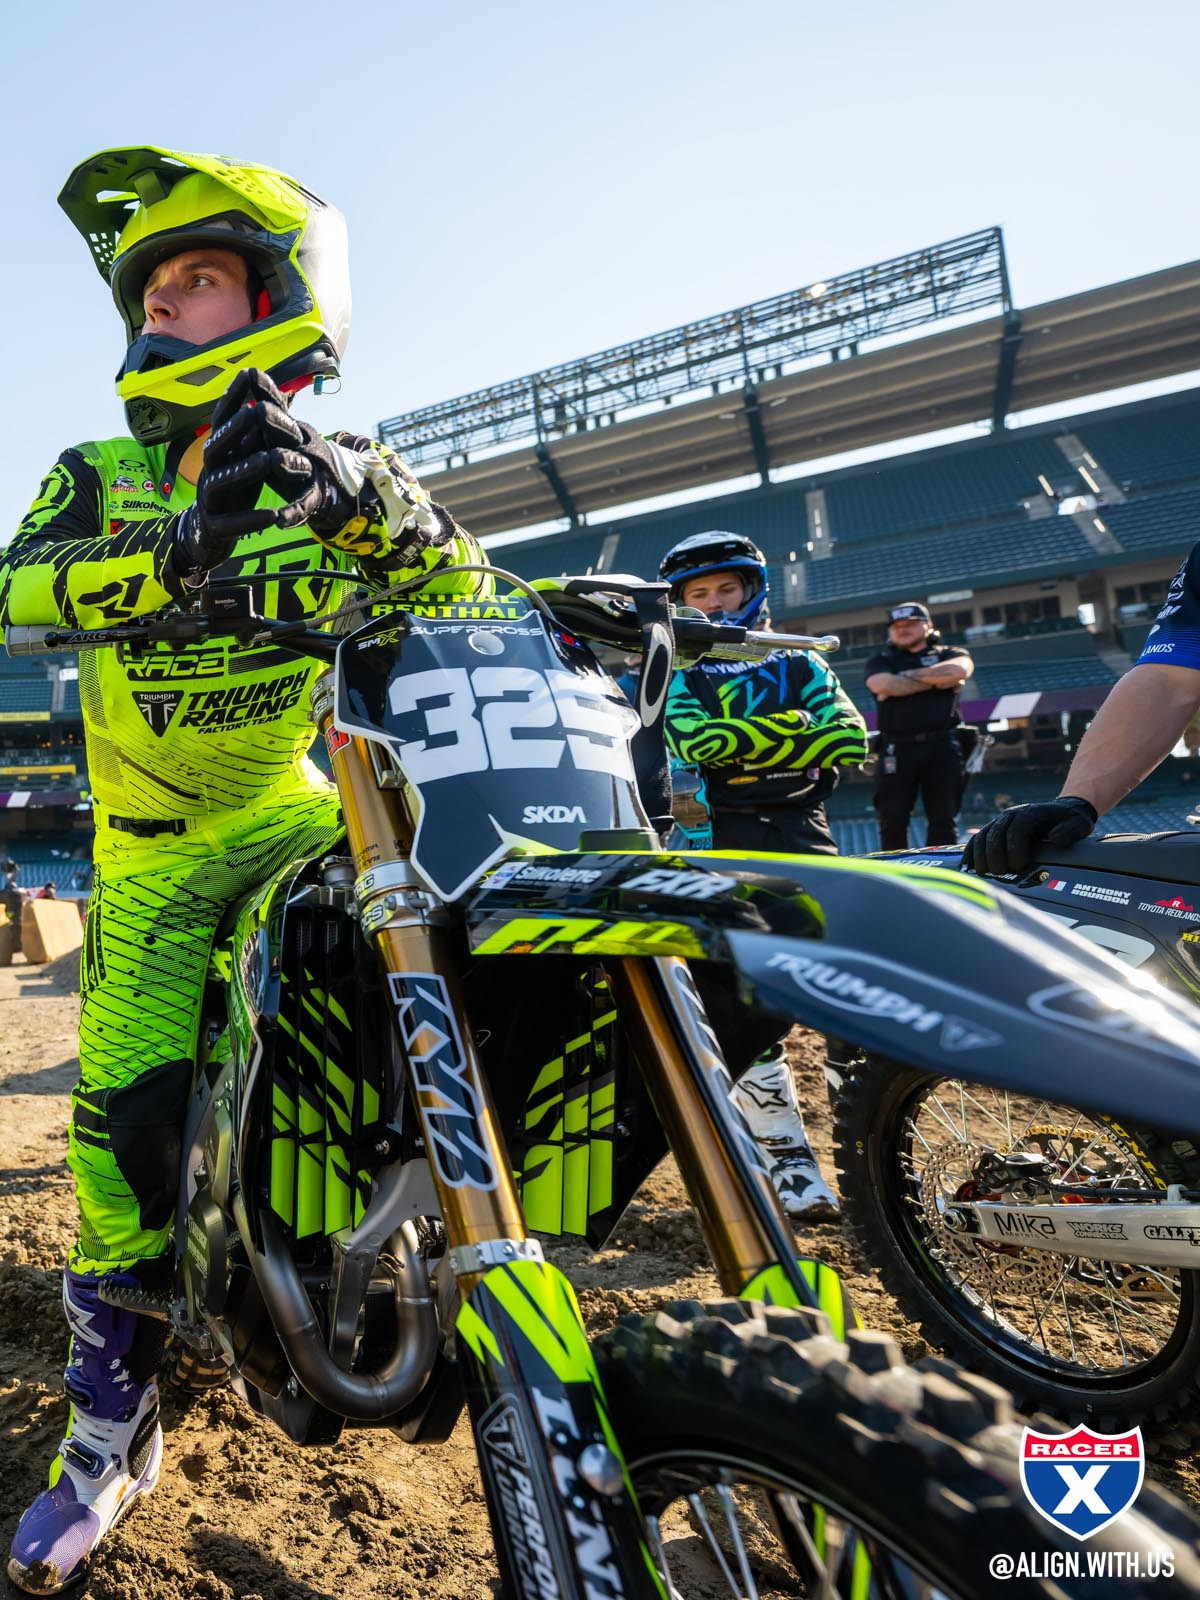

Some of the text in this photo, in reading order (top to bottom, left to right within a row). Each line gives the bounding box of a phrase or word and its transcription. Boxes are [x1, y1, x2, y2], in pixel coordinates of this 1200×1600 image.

[371, 604, 527, 619] RENTHAL
[68, 632, 107, 643] ARC
[408, 624, 544, 638] SUPERCROSS
[124, 655, 225, 679] RACE
[139, 693, 175, 701] TRIUMPH
[188, 667, 311, 711] TRIUMPH
[178, 689, 303, 728] RACING
[197, 713, 282, 734] FACTORY TEAM
[388, 667, 641, 784] 325
[522, 807, 586, 824] SKDA
[515, 866, 602, 884] Silkolene
[619, 869, 737, 899] FXR
[1073, 883, 1132, 898] ANTHONY
[1070, 889, 1130, 905] BOURDON
[1171, 900, 1181, 908] R
[1137, 902, 1164, 915] TOYOTA
[766, 952, 943, 1033] TRIUMPH
[386, 972, 498, 1191] KYB
[993, 1211, 1057, 1239] Mika
[1071, 1222, 1123, 1233] WORKS
[1074, 1230, 1127, 1240] CONNECTION
